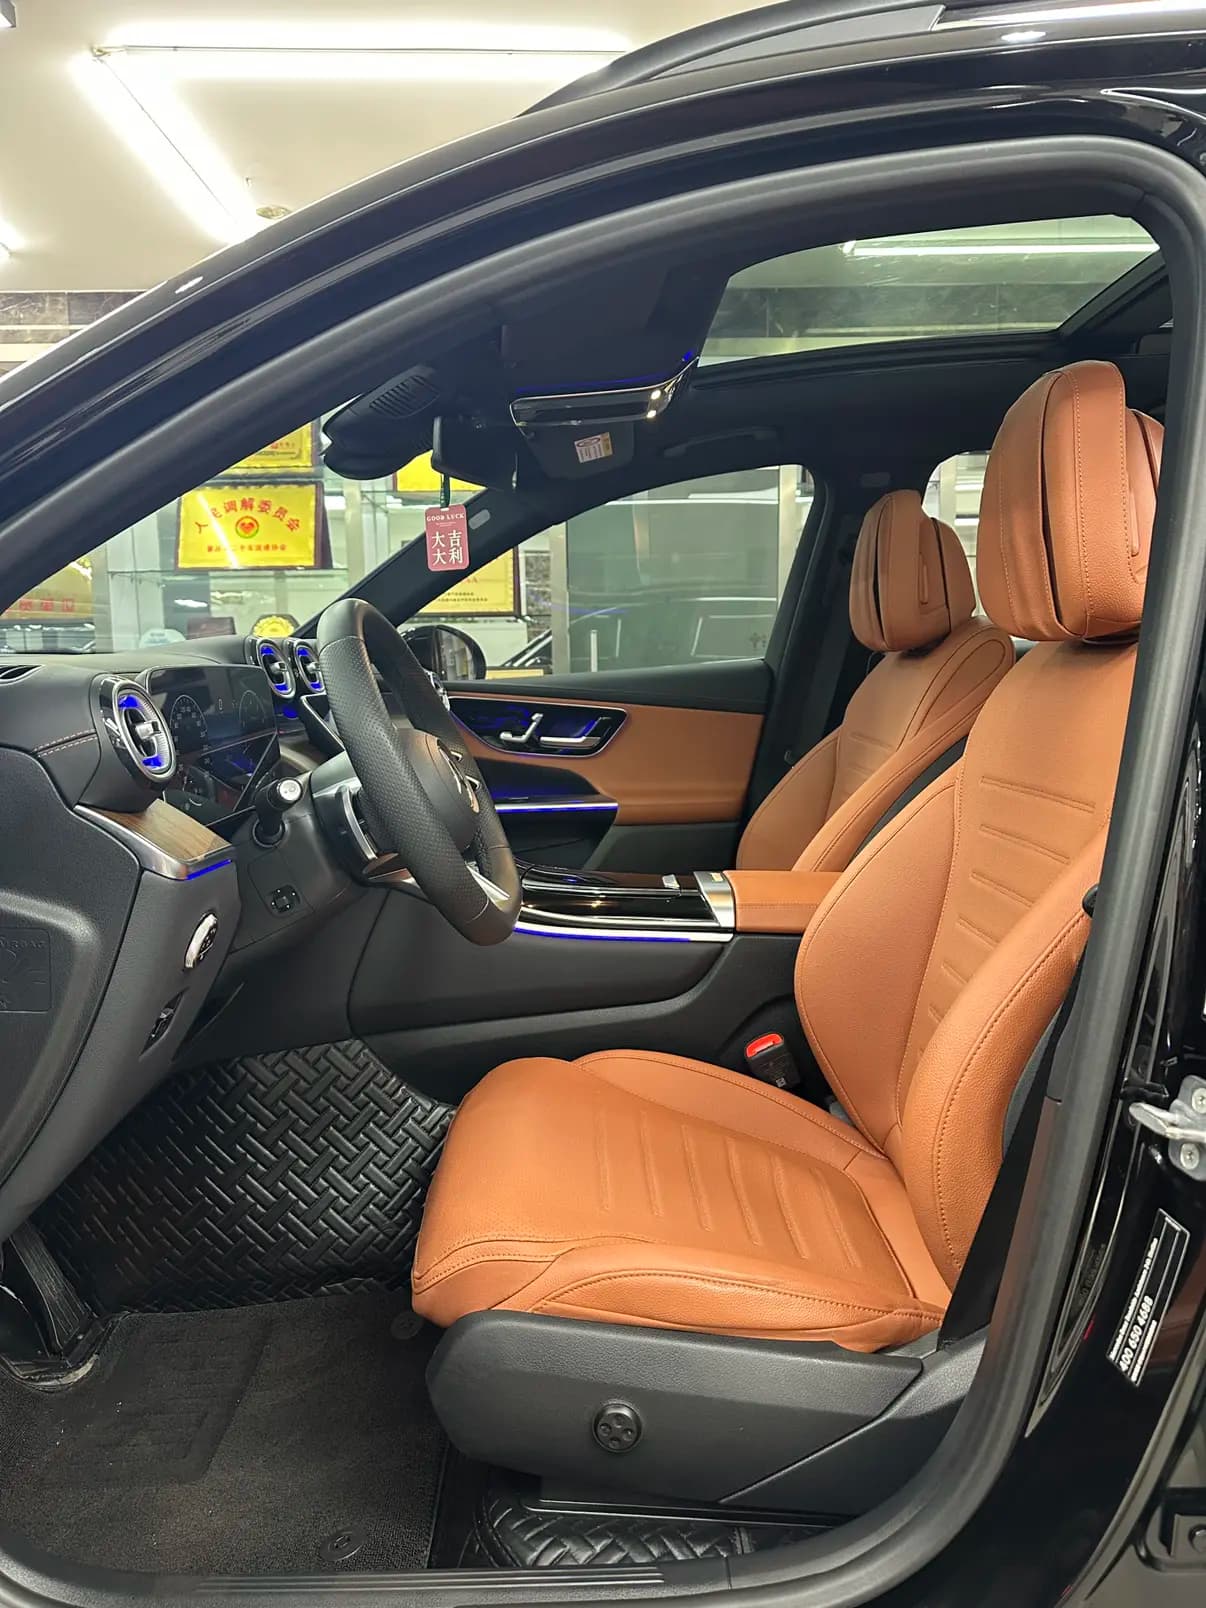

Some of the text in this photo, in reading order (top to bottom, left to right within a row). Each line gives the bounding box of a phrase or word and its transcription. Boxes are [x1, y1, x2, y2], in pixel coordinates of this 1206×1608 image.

[426, 512, 465, 522] GOOD LUCK
[431, 529, 462, 549] 大吉
[432, 547, 463, 566] 大利
[1119, 1346, 1134, 1372] 400
[1128, 1324, 1142, 1350] 650
